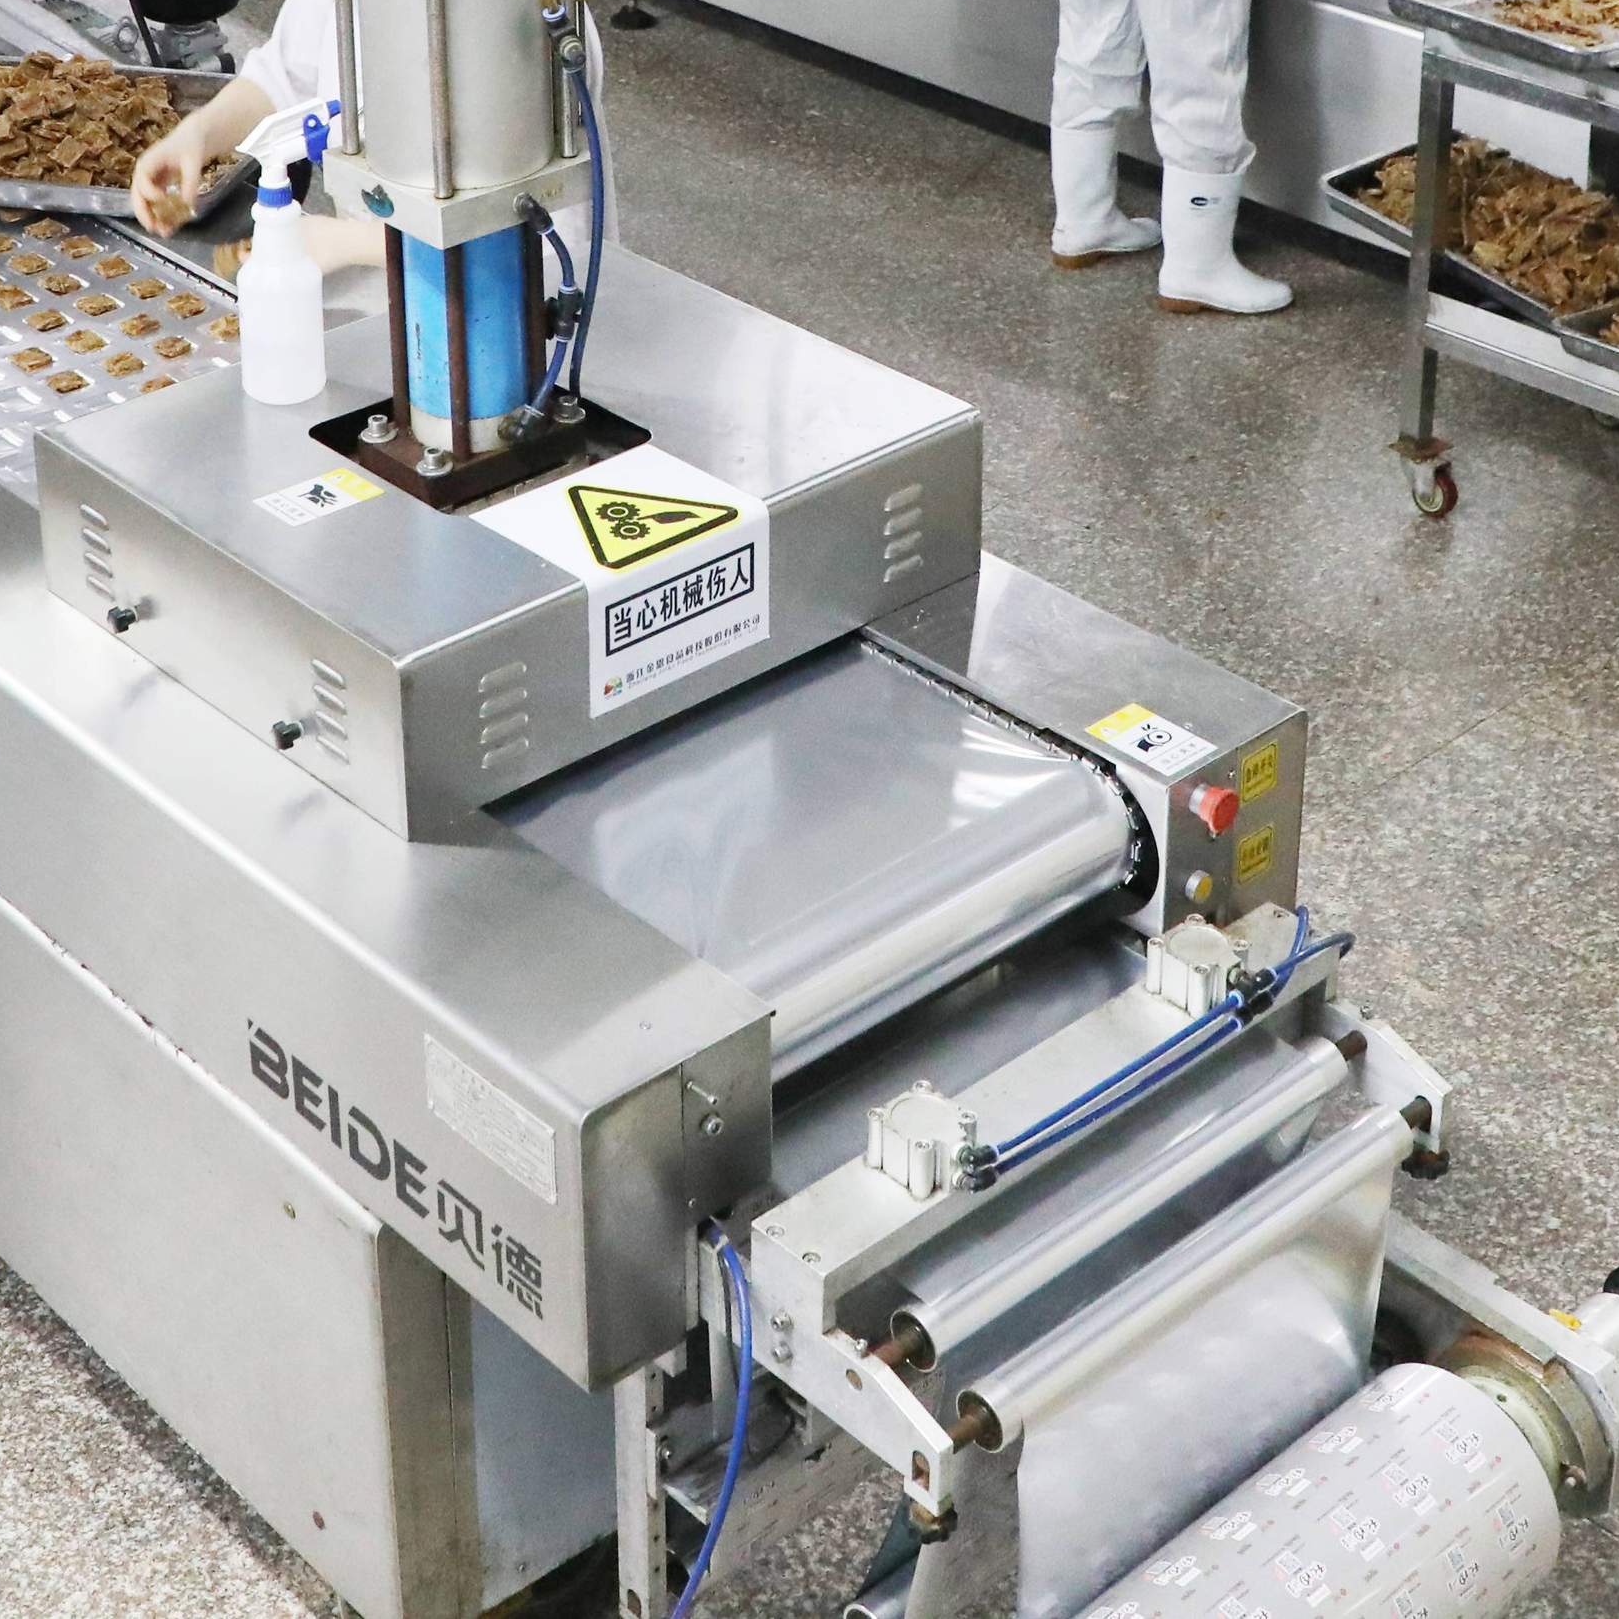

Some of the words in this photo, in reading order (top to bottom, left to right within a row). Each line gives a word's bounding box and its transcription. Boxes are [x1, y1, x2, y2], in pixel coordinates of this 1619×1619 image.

[613, 557, 749, 643] 当心机械伤人
